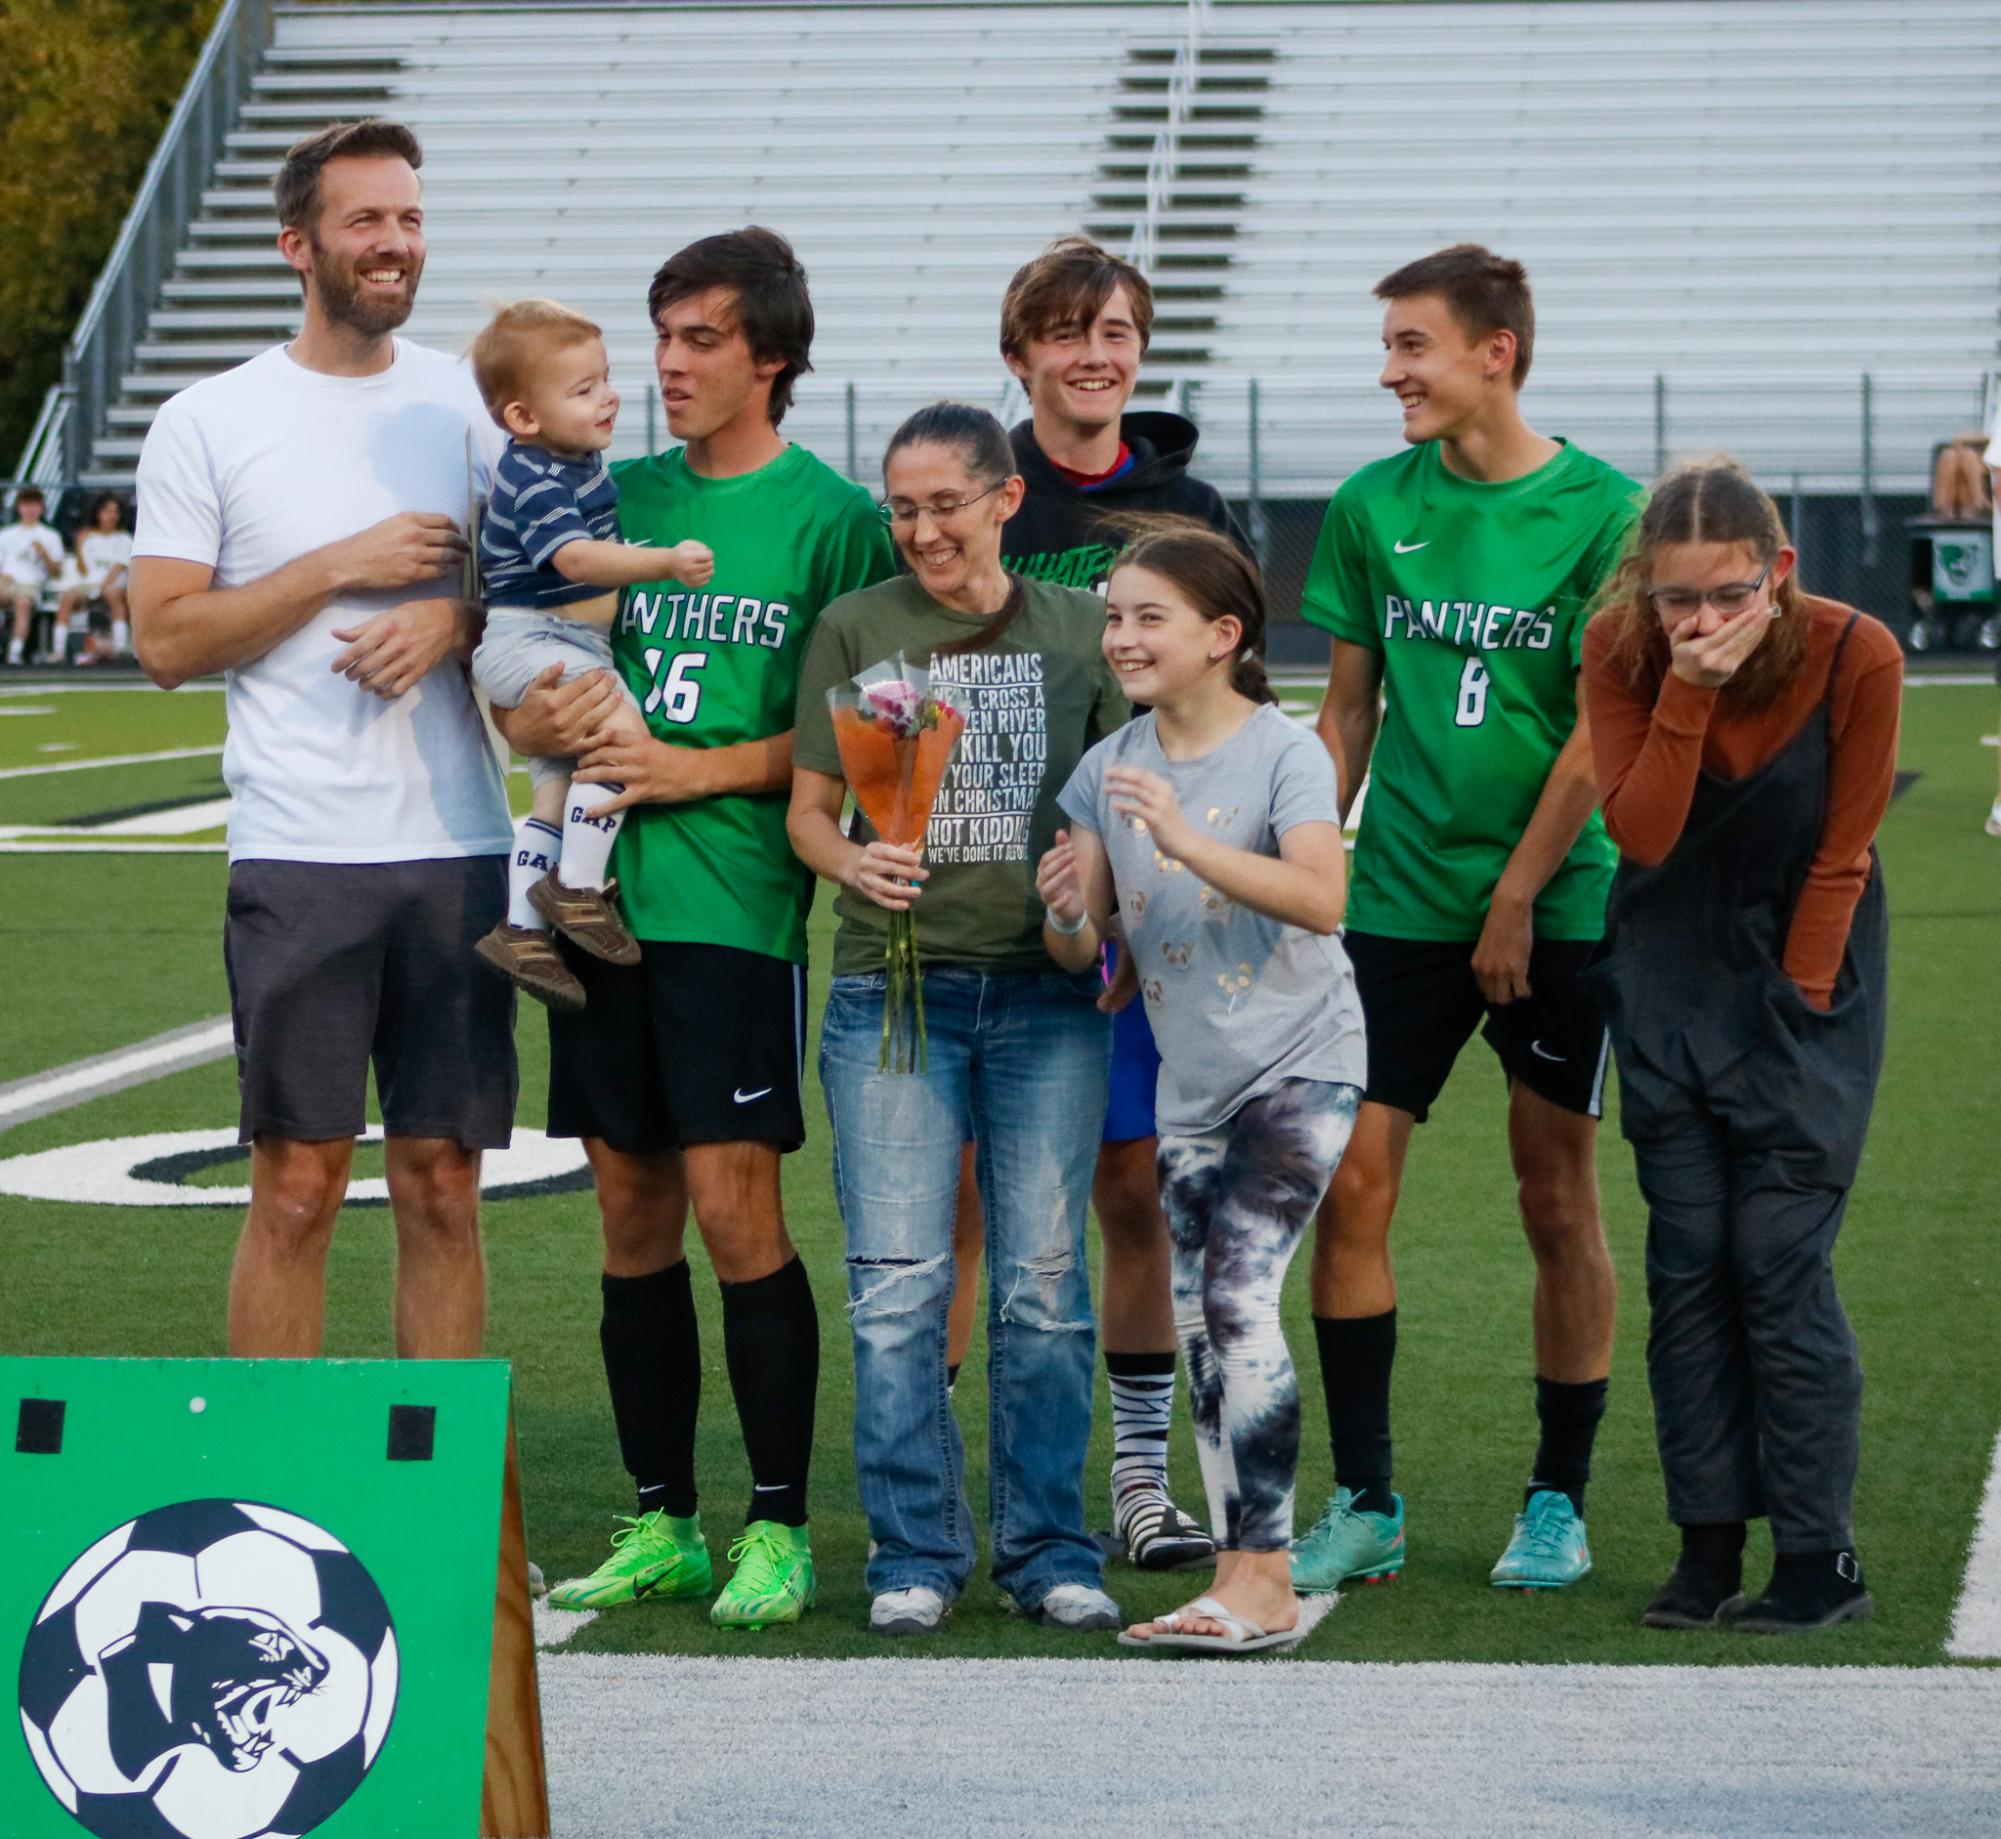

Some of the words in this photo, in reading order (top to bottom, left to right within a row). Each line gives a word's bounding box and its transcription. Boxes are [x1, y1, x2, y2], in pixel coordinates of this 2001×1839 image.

[620, 591, 789, 649] ANTHERS
[1383, 594, 1556, 650] PANTHERS
[928, 652, 1044, 684] AMERICANS
[643, 647, 708, 724] 16
[978, 688, 1030, 710] CROSS
[1034, 686, 1045, 707] A
[1454, 655, 1490, 727] 8
[963, 711, 993, 734] ZEN
[998, 709, 1047, 733] RIVER
[960, 734, 1003, 763] KILL
[1009, 733, 1047, 762] YOU
[951, 765, 994, 789] YOUR
[999, 763, 1047, 788] SLEEP
[927, 819, 965, 846] NOT
[969, 816, 1032, 845] KIDDING
[517, 850, 553, 873] GA
[928, 847, 959, 864] WE'VE
[962, 846, 991, 862] DONE
[992, 845, 1004, 860] IT
